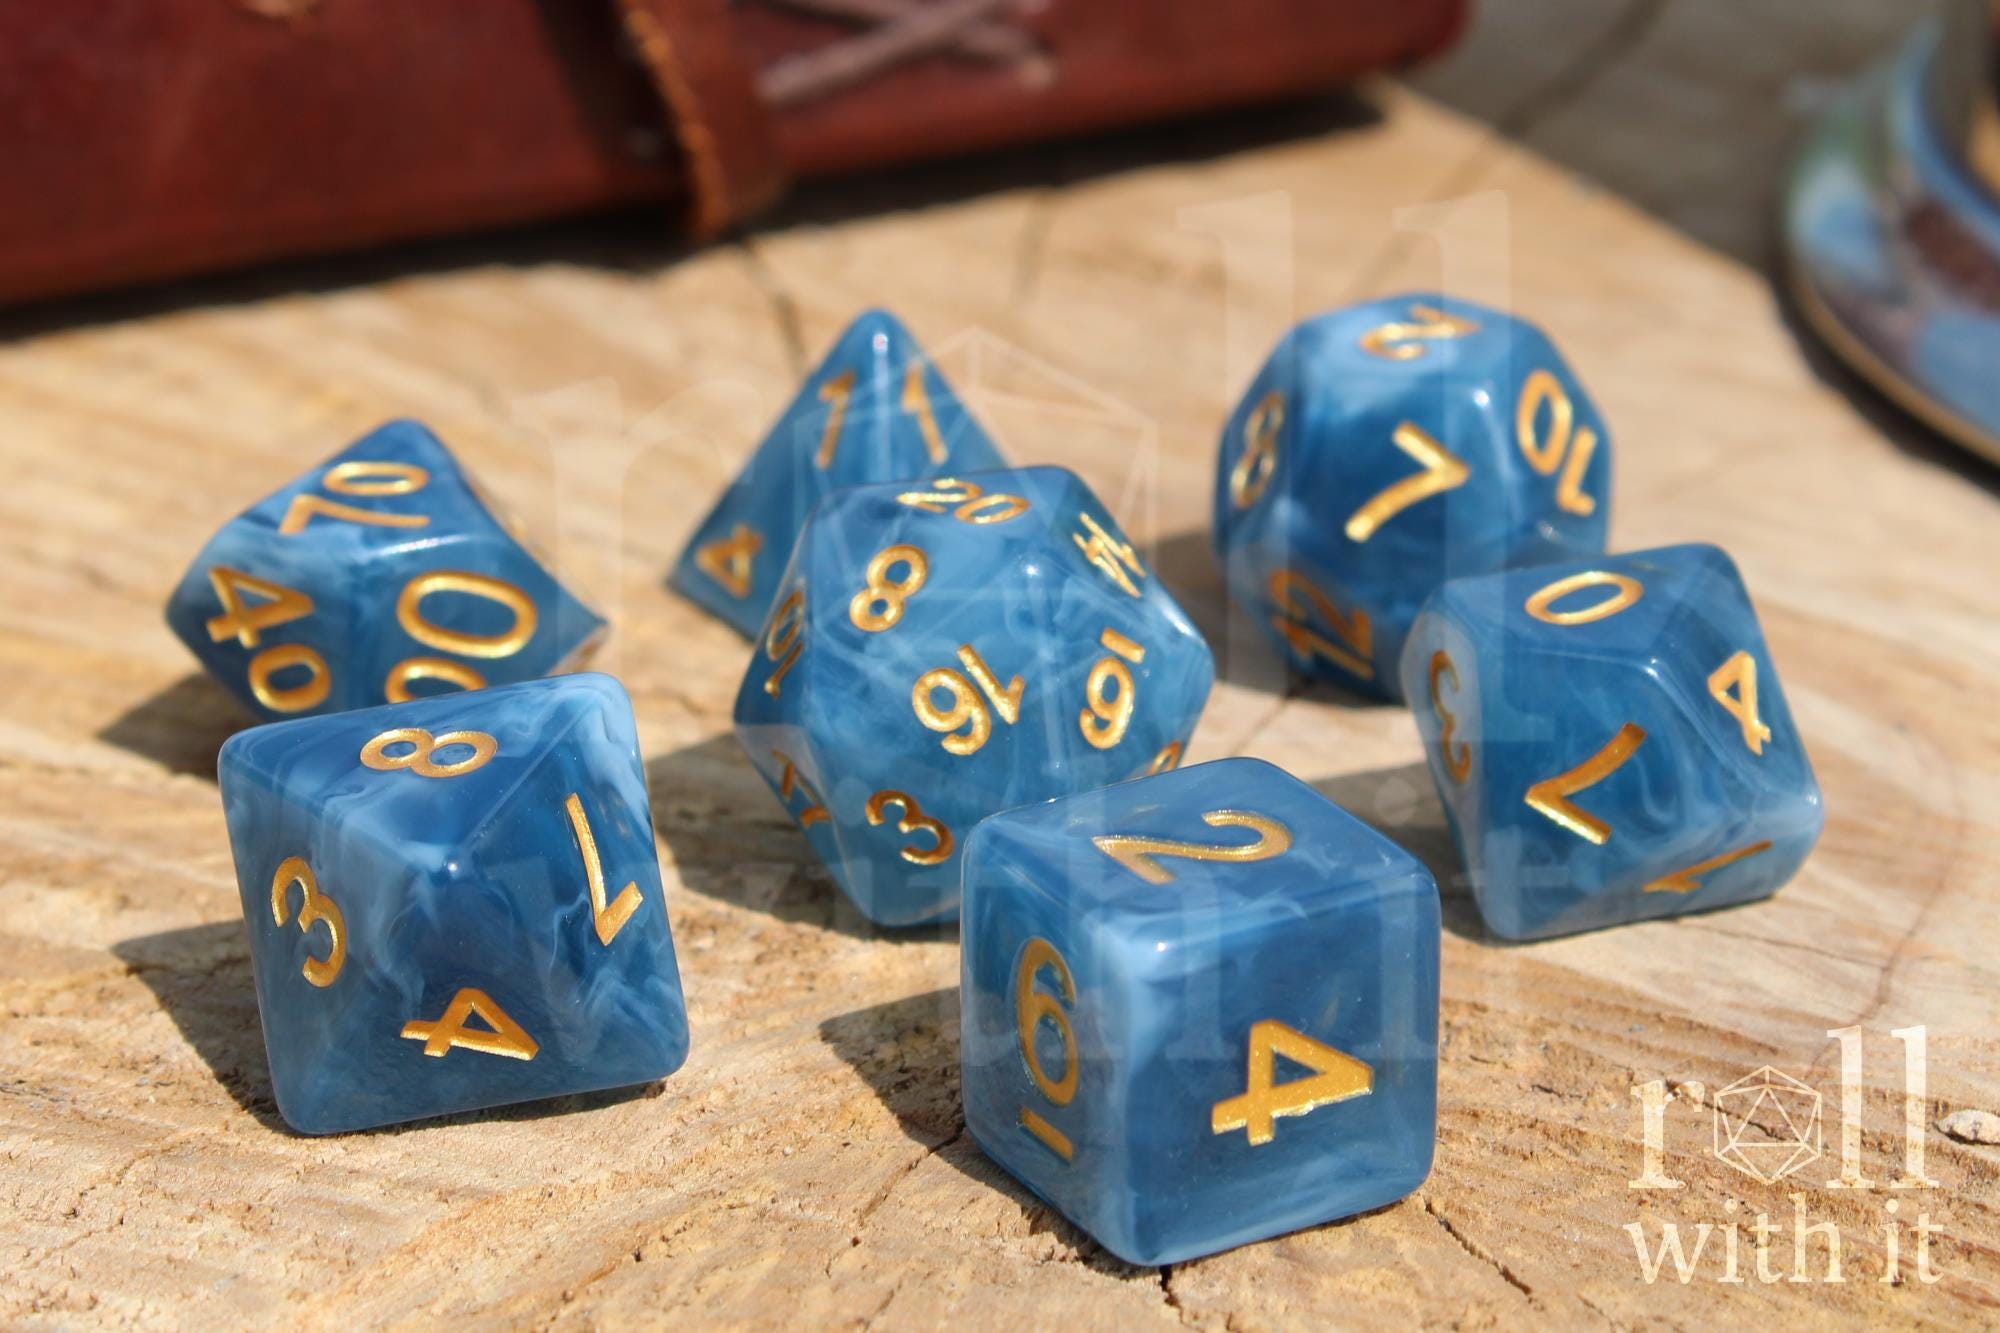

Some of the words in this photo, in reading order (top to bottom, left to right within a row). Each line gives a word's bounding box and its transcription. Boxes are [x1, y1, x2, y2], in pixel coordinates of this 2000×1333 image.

[1359, 303, 1481, 360] 2
[814, 367, 855, 469] 1
[901, 359, 947, 464] 1
[1230, 391, 1285, 508] 8
[1516, 370, 1597, 516] 10
[896, 478, 1030, 525] 20
[1345, 421, 1471, 543] 7
[695, 523, 763, 598] 4
[849, 544, 928, 632] 8
[1525, 570, 1645, 626] 0
[911, 643, 1026, 756] 16
[1429, 650, 1470, 784] 3
[1708, 651, 1771, 756] 4
[360, 727, 498, 779] 8
[1524, 722, 1647, 845] 7
[865, 789, 954, 866] 3
[1093, 809, 1294, 885] 2
[271, 856, 346, 987] 3
[401, 987, 539, 1061] 4
[1211, 1018, 1375, 1147] 4
